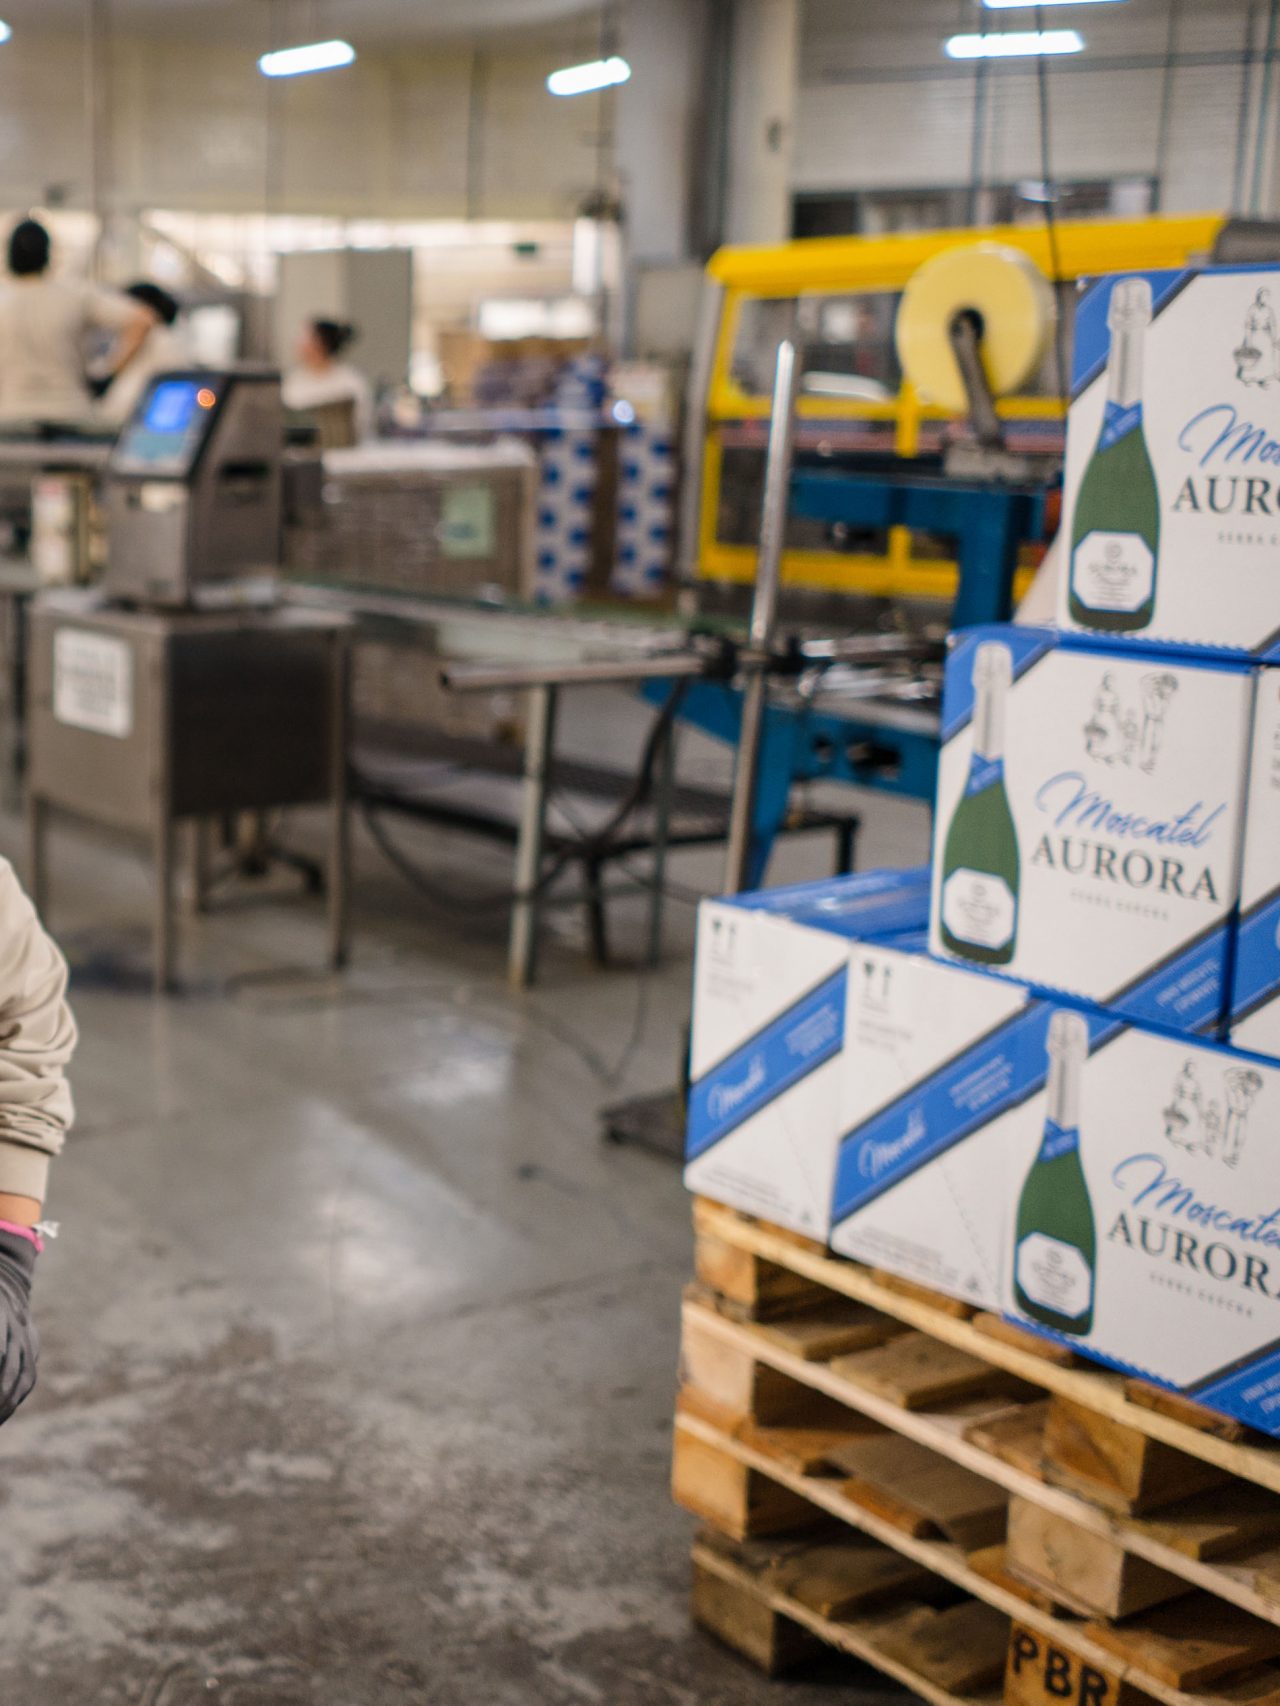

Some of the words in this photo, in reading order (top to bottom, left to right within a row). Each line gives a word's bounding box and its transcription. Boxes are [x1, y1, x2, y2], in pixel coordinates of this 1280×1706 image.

[1170, 474, 1280, 517] AUR
[1035, 770, 1228, 848] Moscatel
[1031, 831, 1223, 904] AURORA
[1106, 1210, 1280, 1300] AUROR
[1012, 1630, 1109, 1706] PBR
